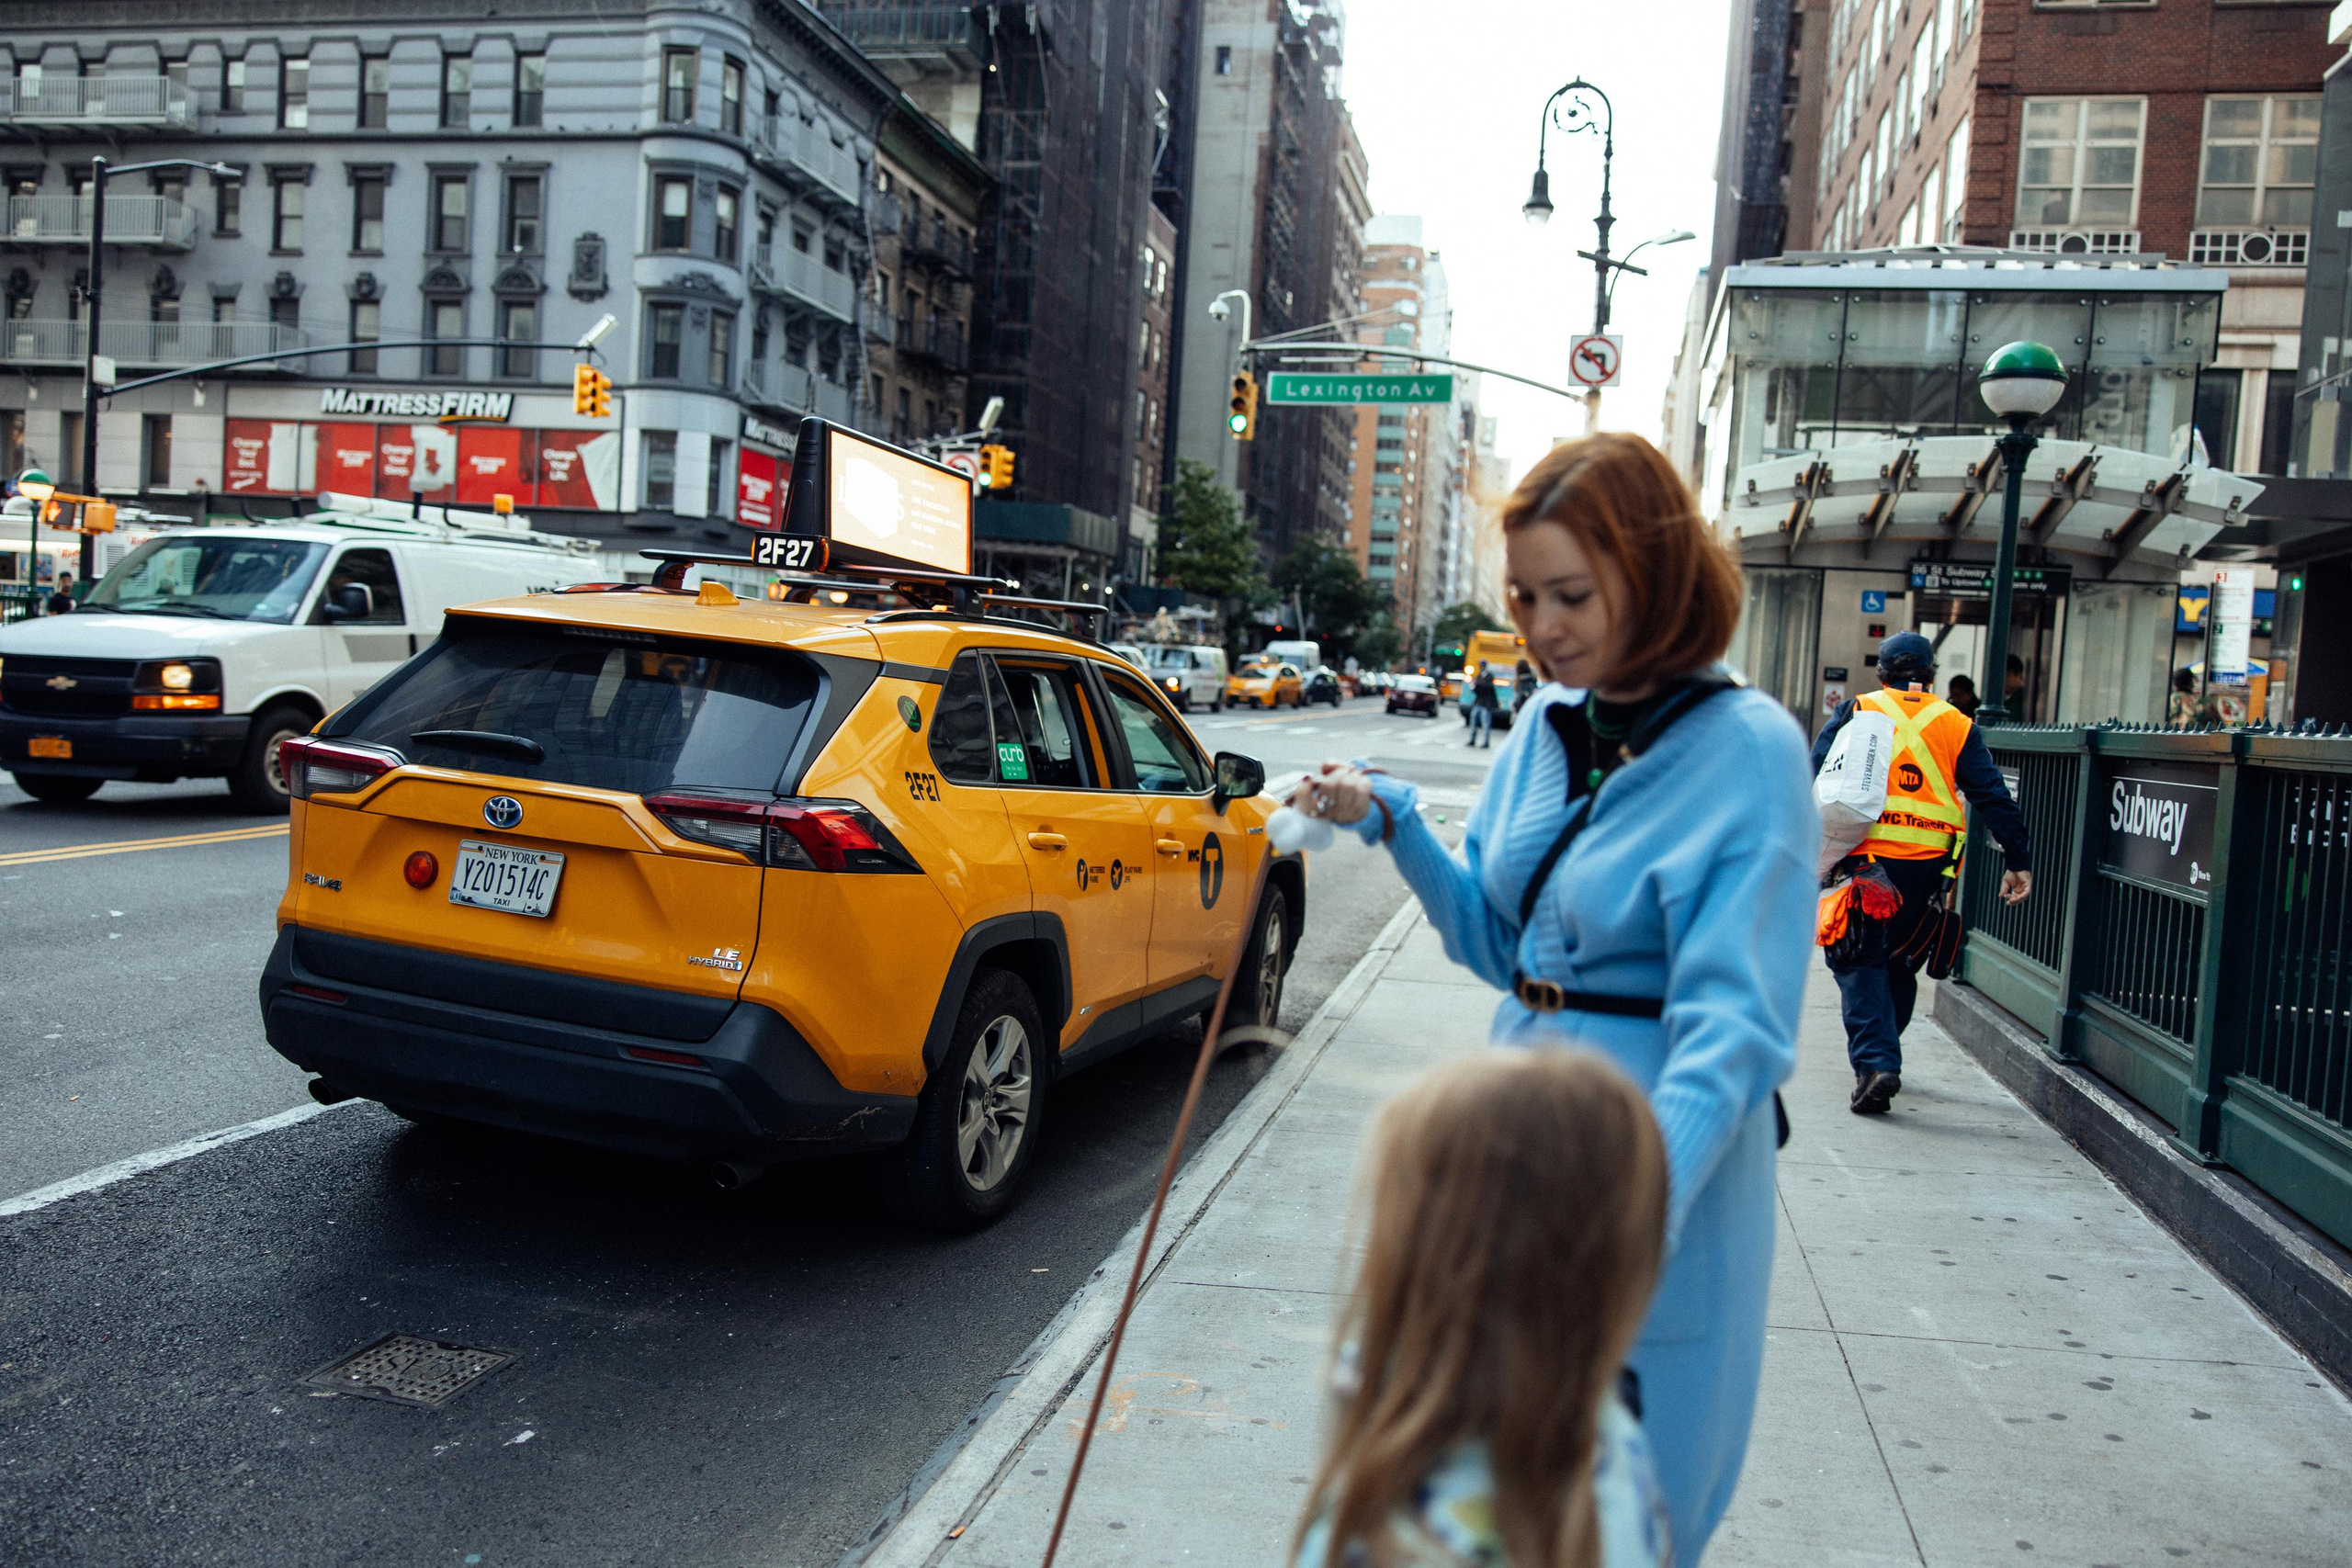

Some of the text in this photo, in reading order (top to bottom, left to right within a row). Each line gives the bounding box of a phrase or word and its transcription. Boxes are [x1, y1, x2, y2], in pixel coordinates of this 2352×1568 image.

[1286, 381, 1436, 401] Lexington Av
[758, 537, 814, 567] 2F27
[1946, 566, 1987, 580] Subway
[1951, 578, 1983, 588] Uptown
[999, 746, 1024, 762] curb
[1860, 733, 1878, 792] STEVEMADDEN.COM
[1898, 768, 1919, 786] MTA
[905, 772, 941, 802] 2F27
[1905, 814, 1945, 830] Transit
[2109, 781, 2188, 856] Subway
[484, 847, 539, 865] NEW YORK
[303, 872, 343, 892] RAV4
[463, 857, 549, 901] Y201514C
[493, 897, 510, 907] TAXI
[688, 955, 734, 969] HYBRID
[712, 948, 741, 961] LE
